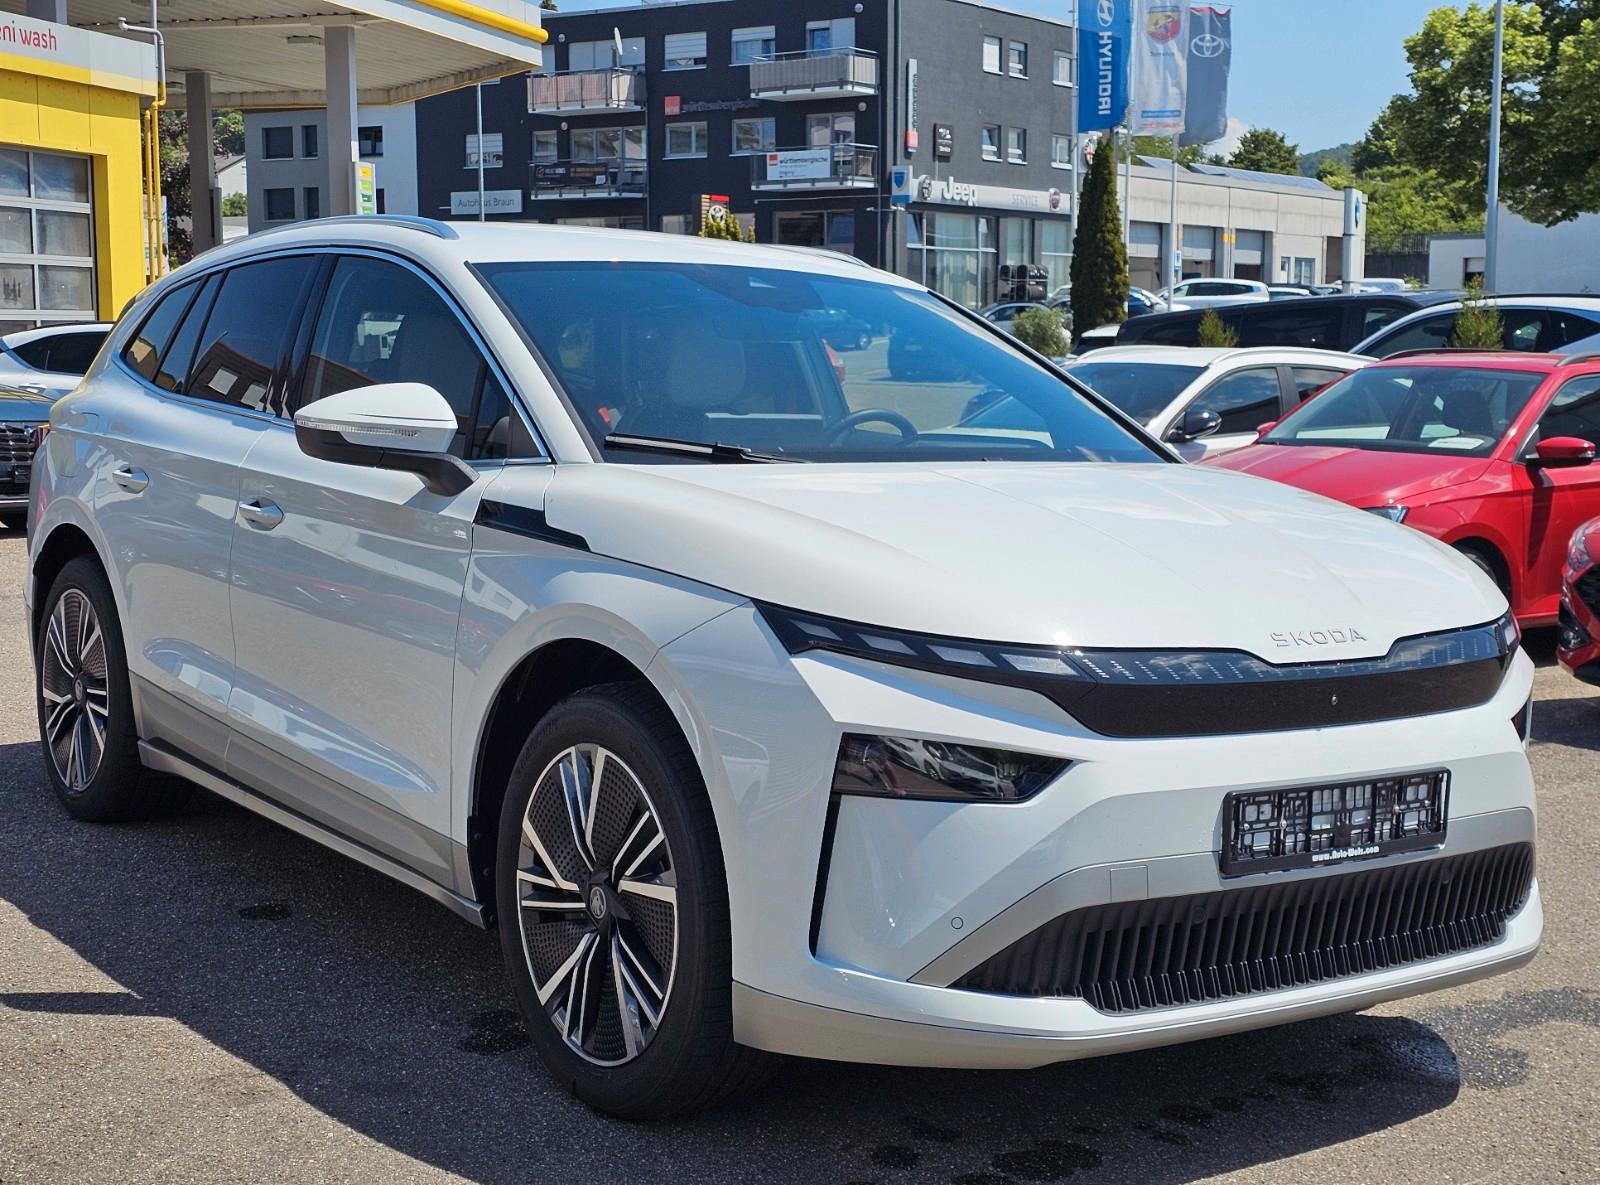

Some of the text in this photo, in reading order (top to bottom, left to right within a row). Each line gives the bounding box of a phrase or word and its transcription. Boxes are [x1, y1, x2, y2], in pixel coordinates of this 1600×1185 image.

[0, 20, 57, 51] ni wash
[1098, 31, 1112, 115] HYUNDAI
[942, 176, 977, 206] Jeep
